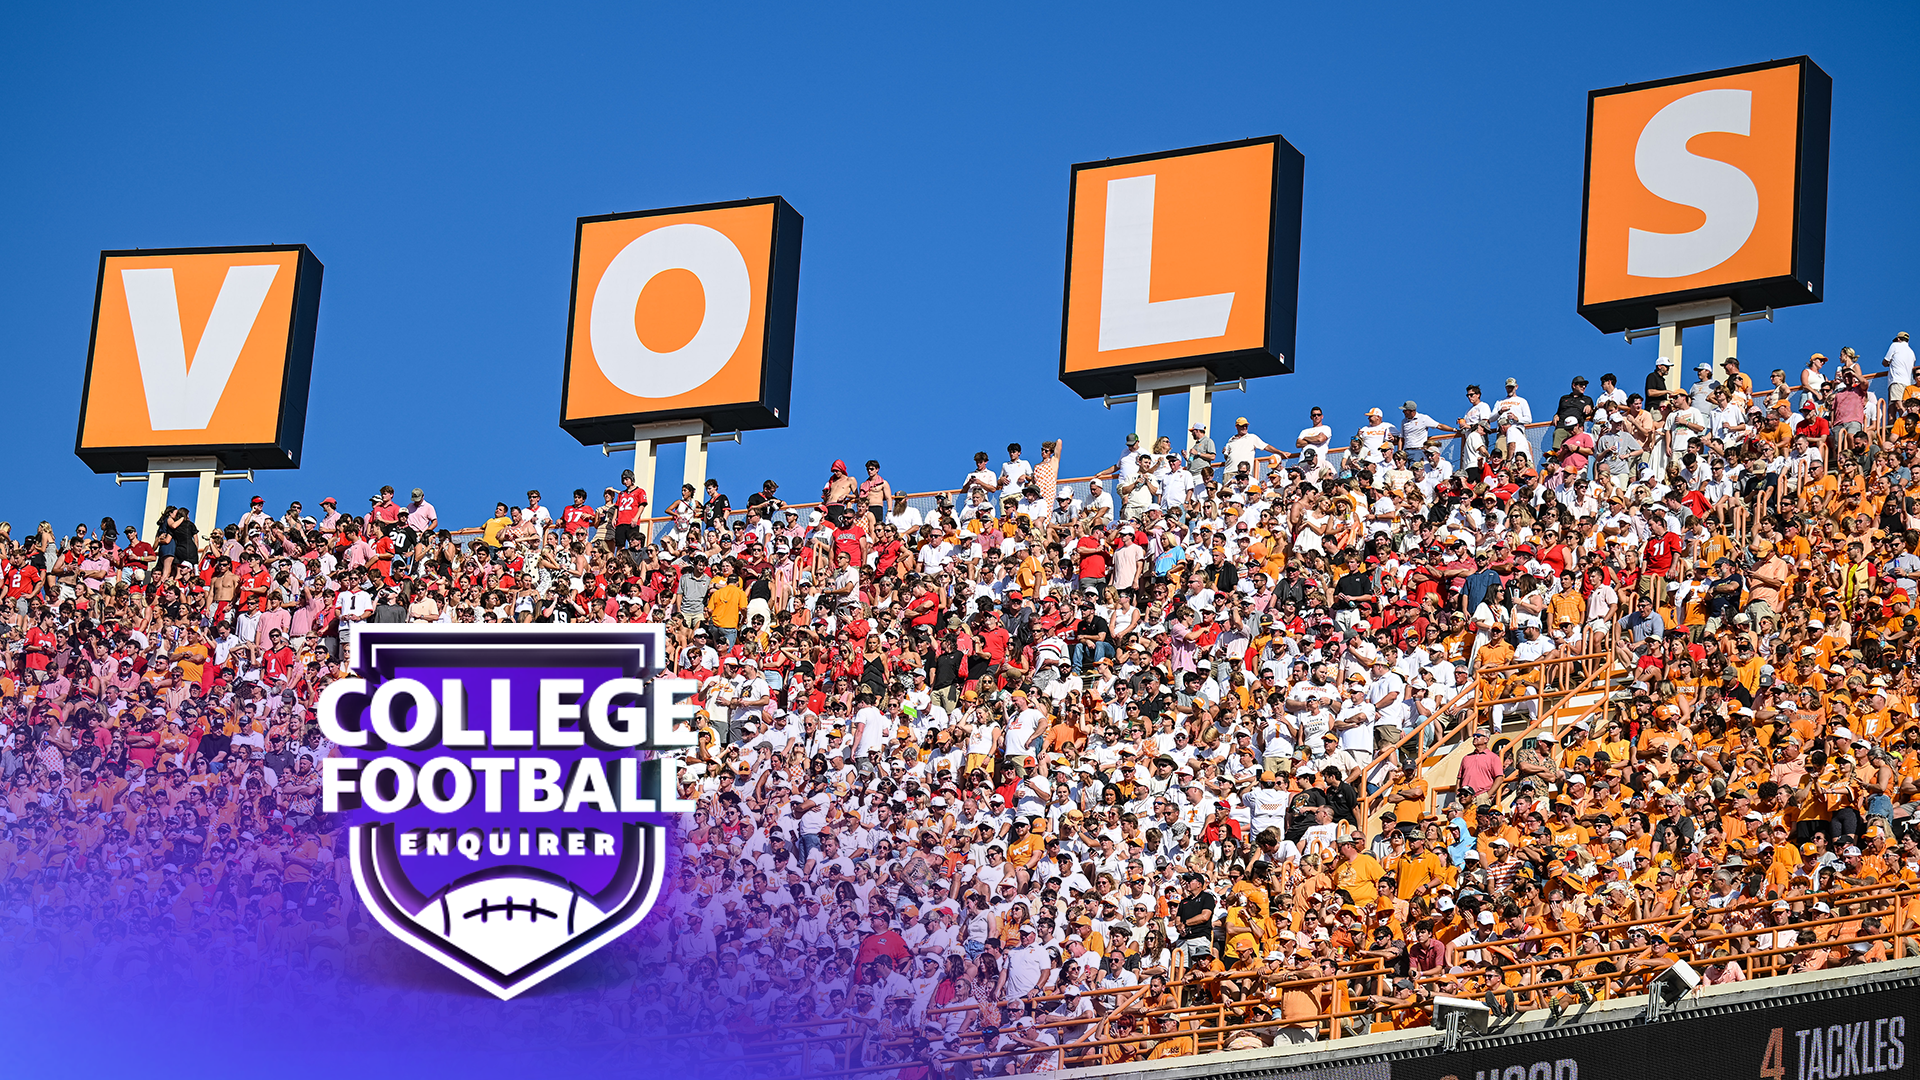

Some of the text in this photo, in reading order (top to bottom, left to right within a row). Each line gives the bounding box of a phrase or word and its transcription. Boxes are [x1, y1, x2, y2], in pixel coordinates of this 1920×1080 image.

[618, 497, 634, 511] 22
[567, 511, 583, 522] 17
[389, 532, 406, 547] 20
[12, 574, 21, 588] 2
[350, 595, 356, 610] 1
[553, 609, 567, 623] 19
[269, 659, 276, 673] 1
[1866, 718, 1878, 735] 16
[1760, 1016, 1905, 1080] 4 TACKLES
